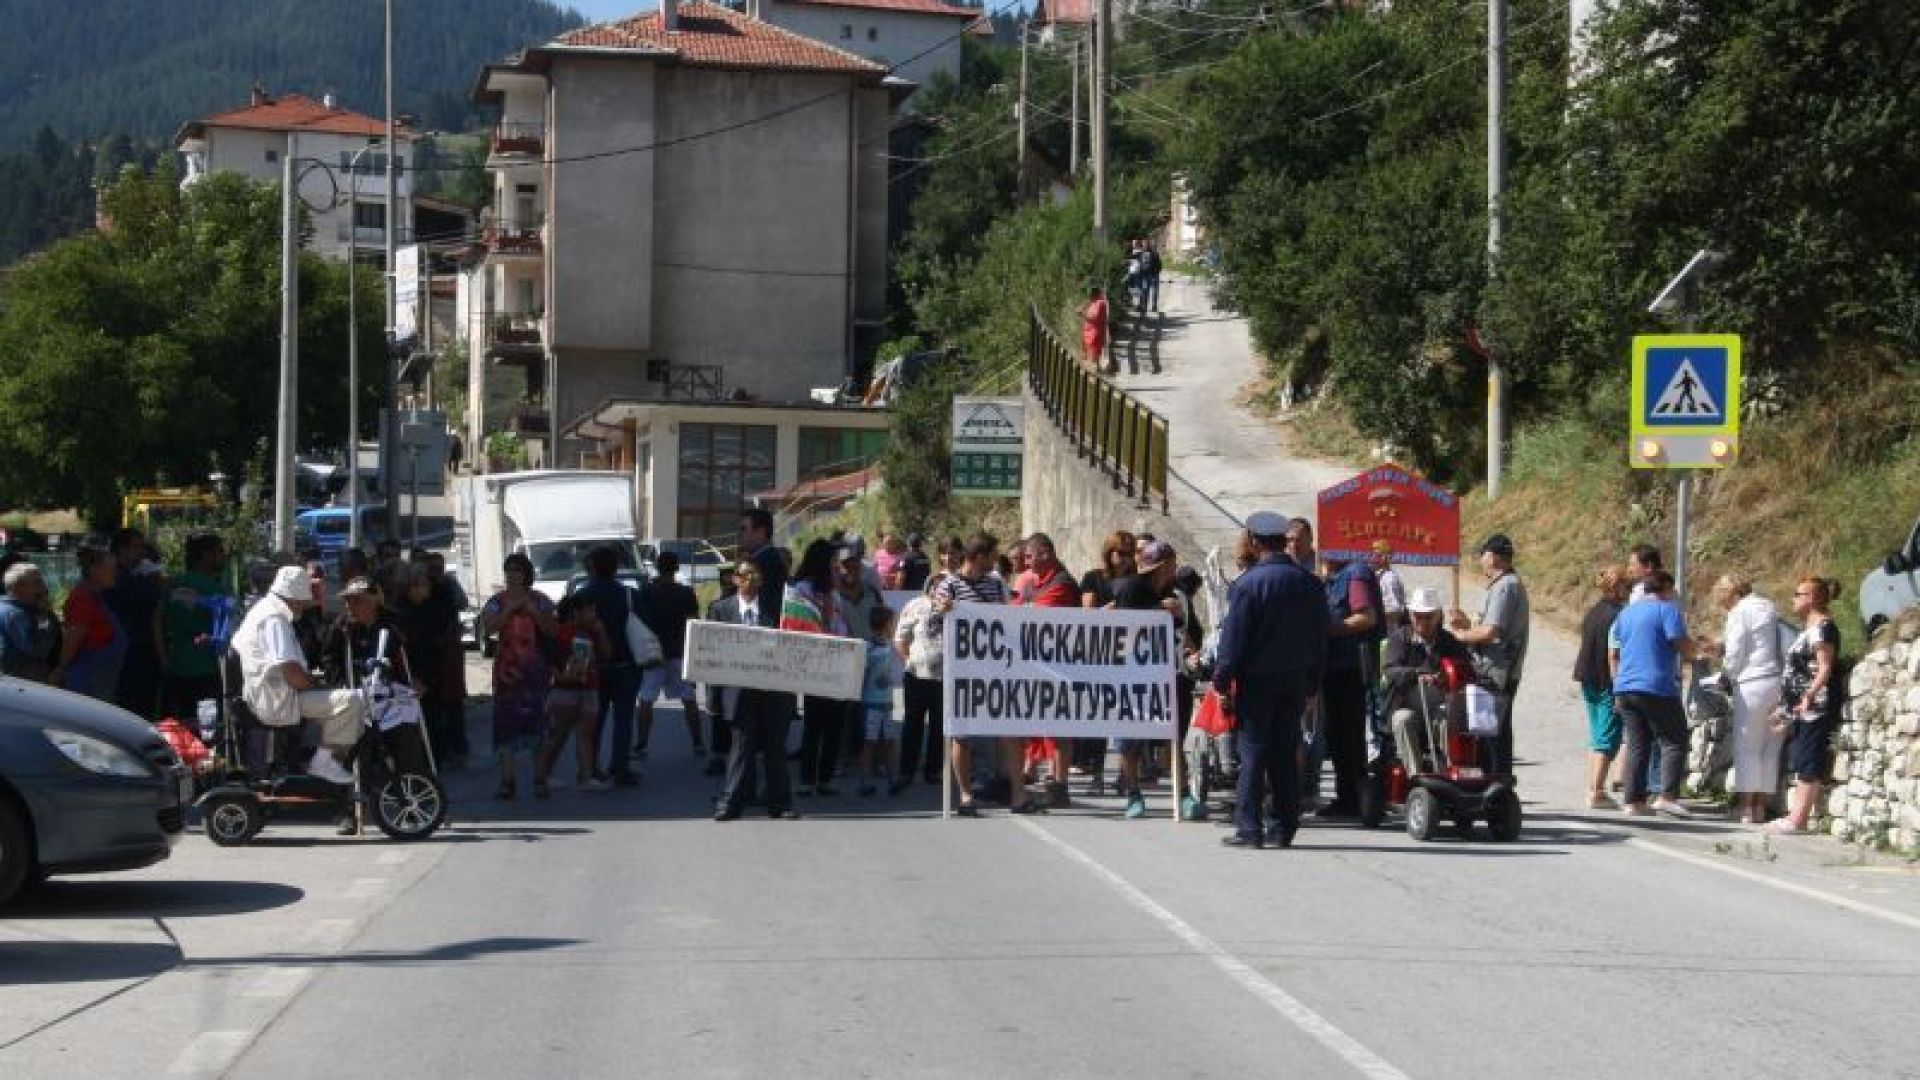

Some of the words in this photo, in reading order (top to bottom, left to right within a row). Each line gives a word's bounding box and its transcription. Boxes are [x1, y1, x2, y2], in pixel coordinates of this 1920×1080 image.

[955, 619, 1013, 667] ВСС,
[1020, 622, 1128, 665] ИСКАМЕ
[1134, 625, 1168, 665] СИ
[954, 678, 1172, 721] ПРОКУРАТУРАТА!
